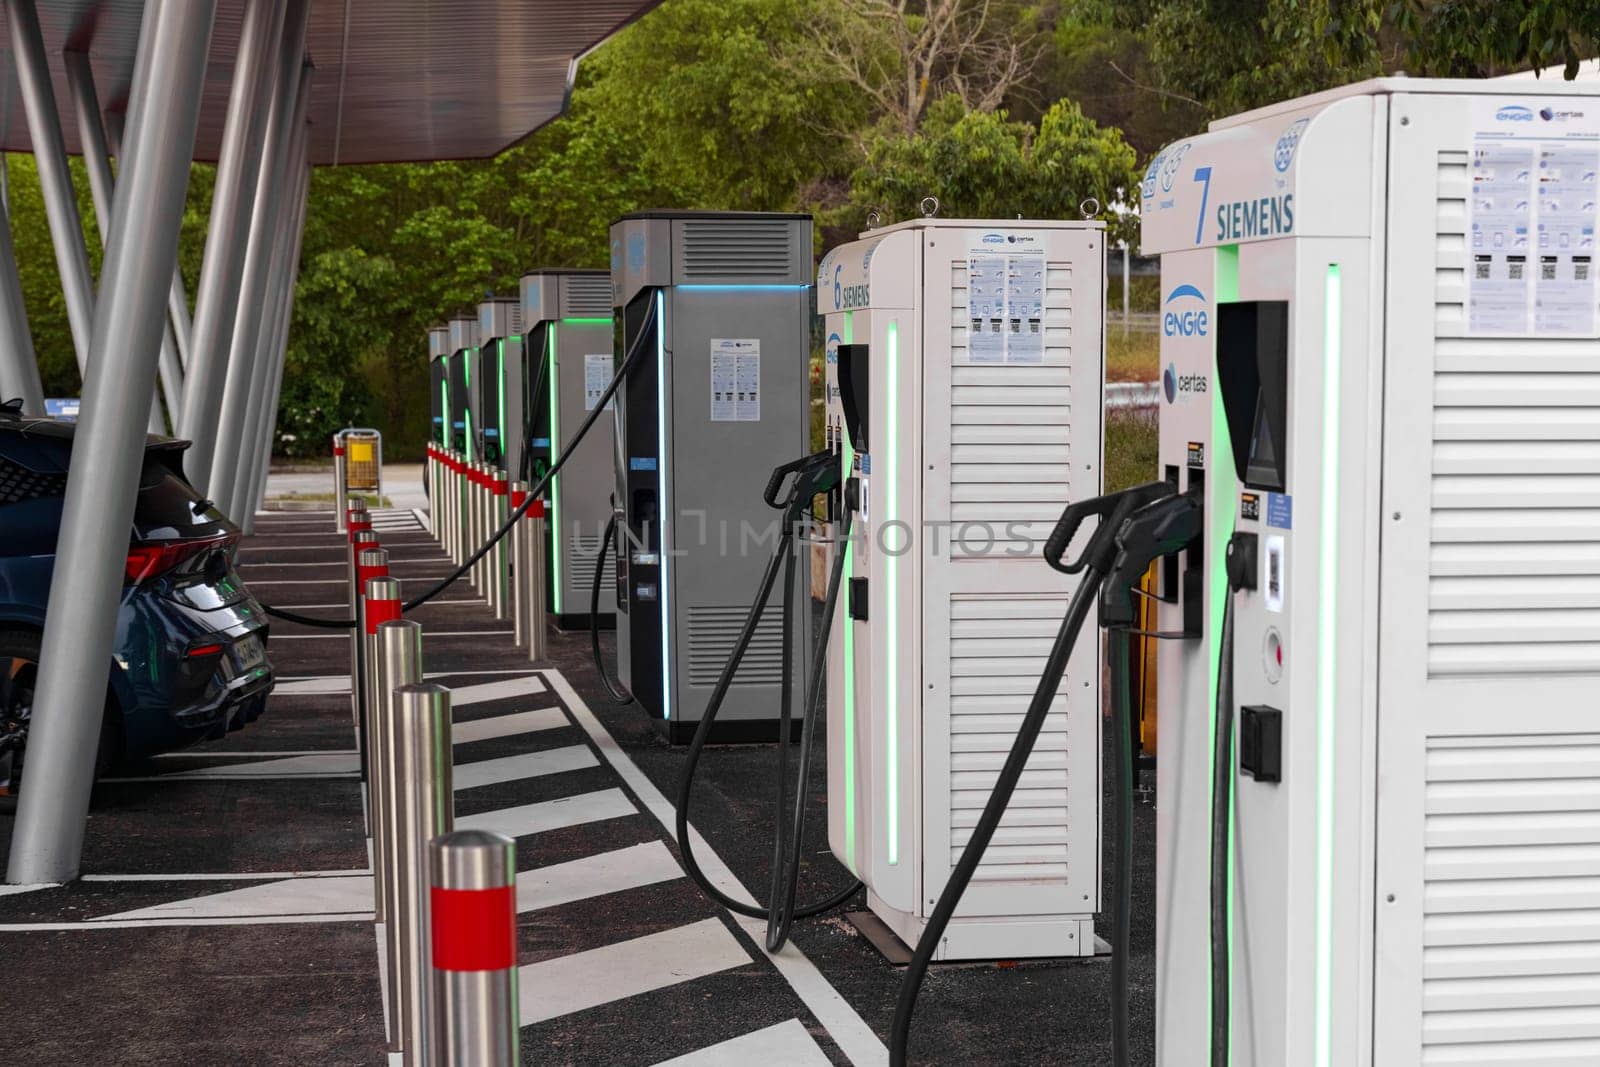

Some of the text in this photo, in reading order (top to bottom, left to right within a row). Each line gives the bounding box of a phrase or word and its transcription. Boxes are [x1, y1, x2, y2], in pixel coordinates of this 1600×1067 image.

[1193, 166, 1212, 245] 7
[1217, 194, 1294, 241] SIEMENS
[834, 265, 842, 310] 6
[843, 284, 870, 308] SIEMENS
[1178, 373, 1207, 392] certas
